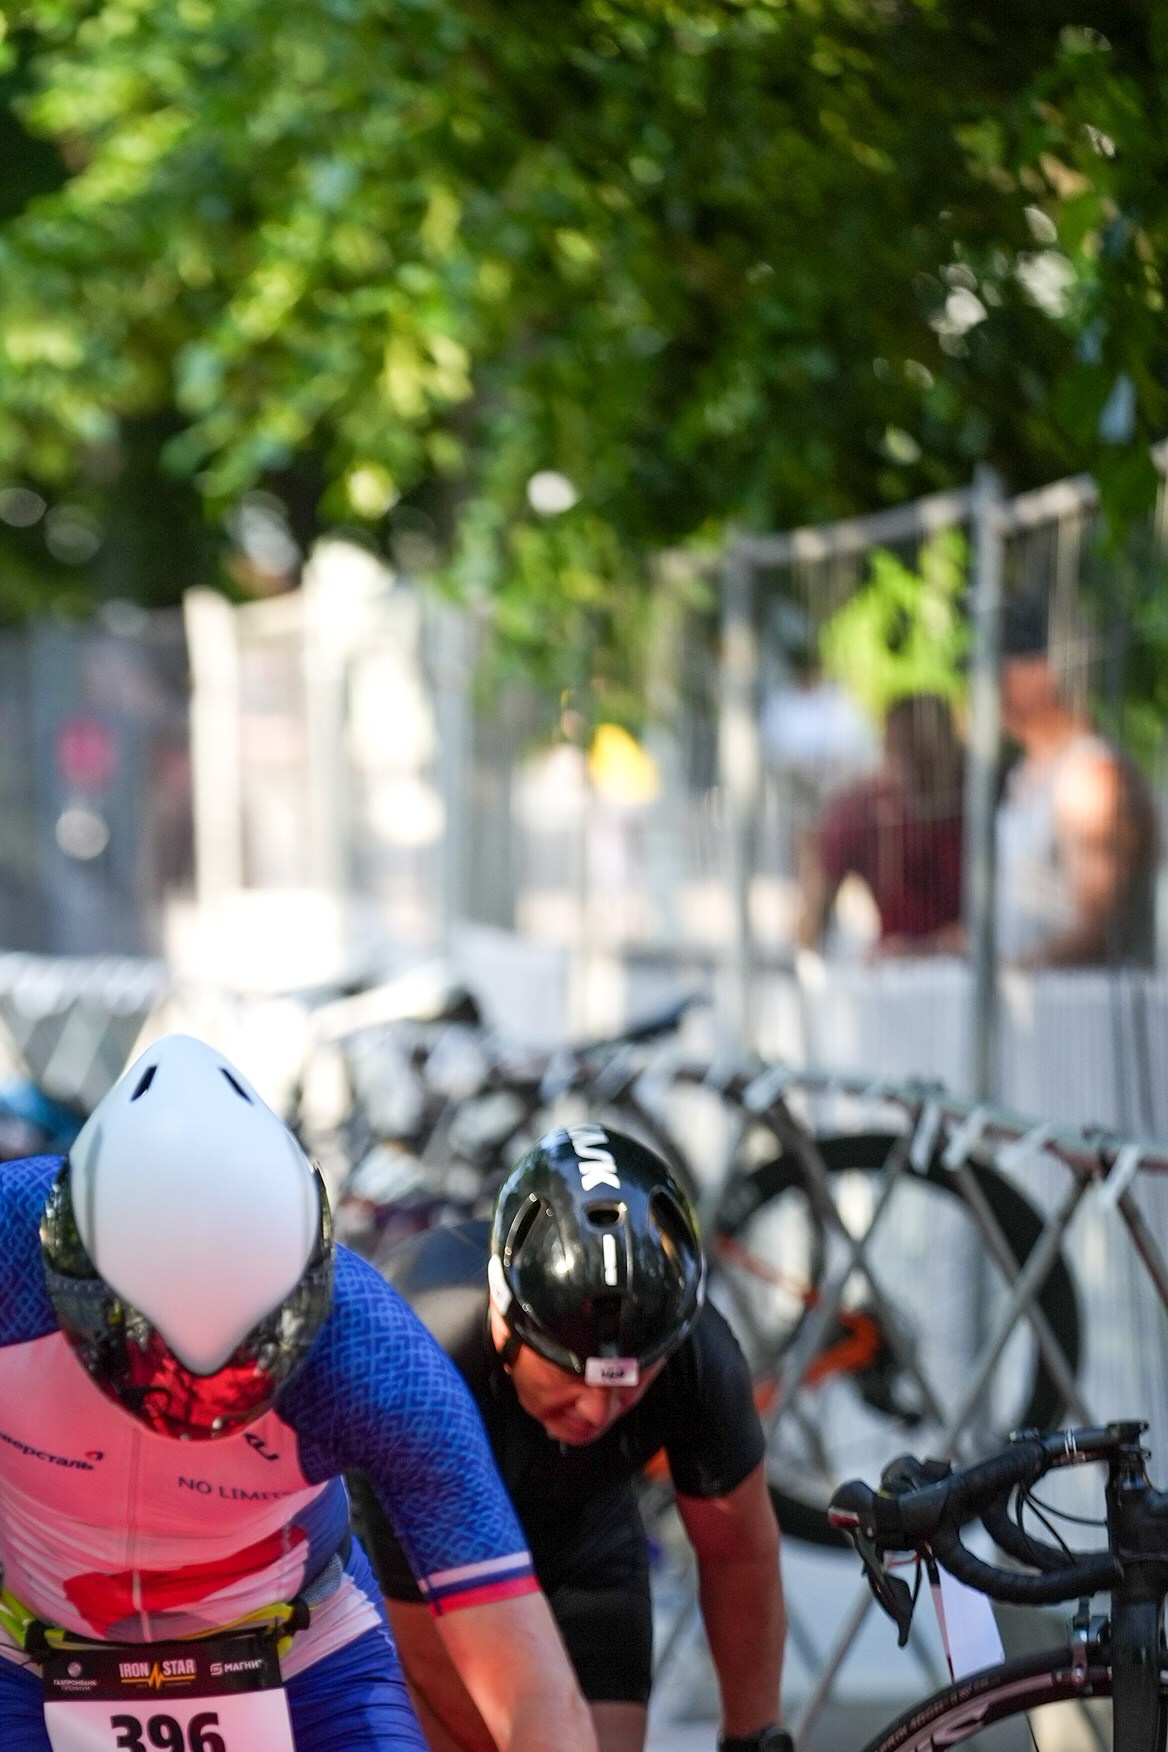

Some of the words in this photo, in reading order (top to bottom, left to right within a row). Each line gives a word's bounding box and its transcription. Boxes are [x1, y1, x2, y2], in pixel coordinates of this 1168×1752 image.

[178, 1476, 211, 1495] NO
[119, 1662, 149, 1678] IRON
[162, 1659, 196, 1676] STAR
